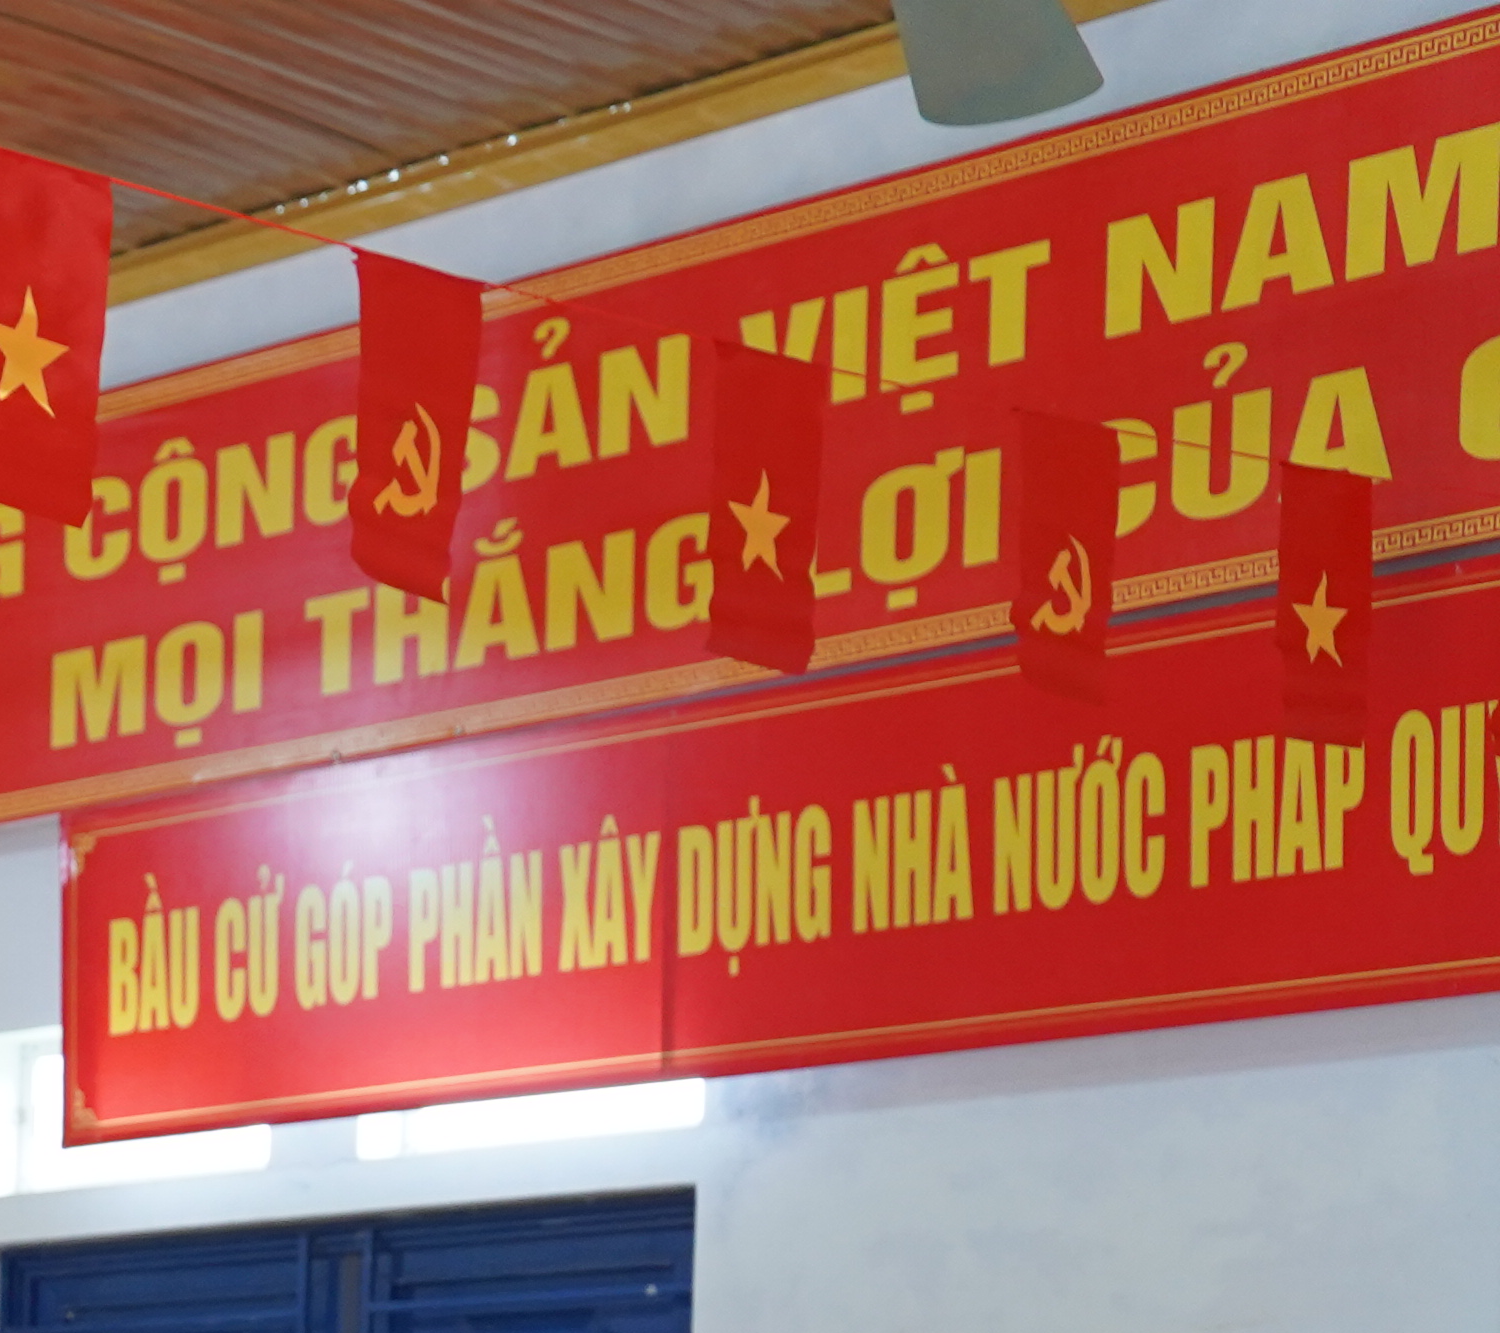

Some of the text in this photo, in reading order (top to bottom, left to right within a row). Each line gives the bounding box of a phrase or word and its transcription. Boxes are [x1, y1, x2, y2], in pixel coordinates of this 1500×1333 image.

[64, 415, 358, 584] CỘNG
[1104, 122, 1500, 339] NAM
[50, 610, 264, 749] MỌI
[305, 512, 714, 697] THẮNG
[809, 446, 1002, 611] ỢI
[108, 873, 199, 1037] BẦU
[214, 863, 284, 1022] CỬ
[295, 861, 392, 1010] GÓP
[408, 815, 543, 993] PHẦN
[558, 815, 660, 972] XÂY
[677, 796, 832, 977] DỰNG
[852, 764, 974, 934] NHÀ
[994, 735, 1167, 914] NƯỚC
[1390, 699, 1500, 876] QU
